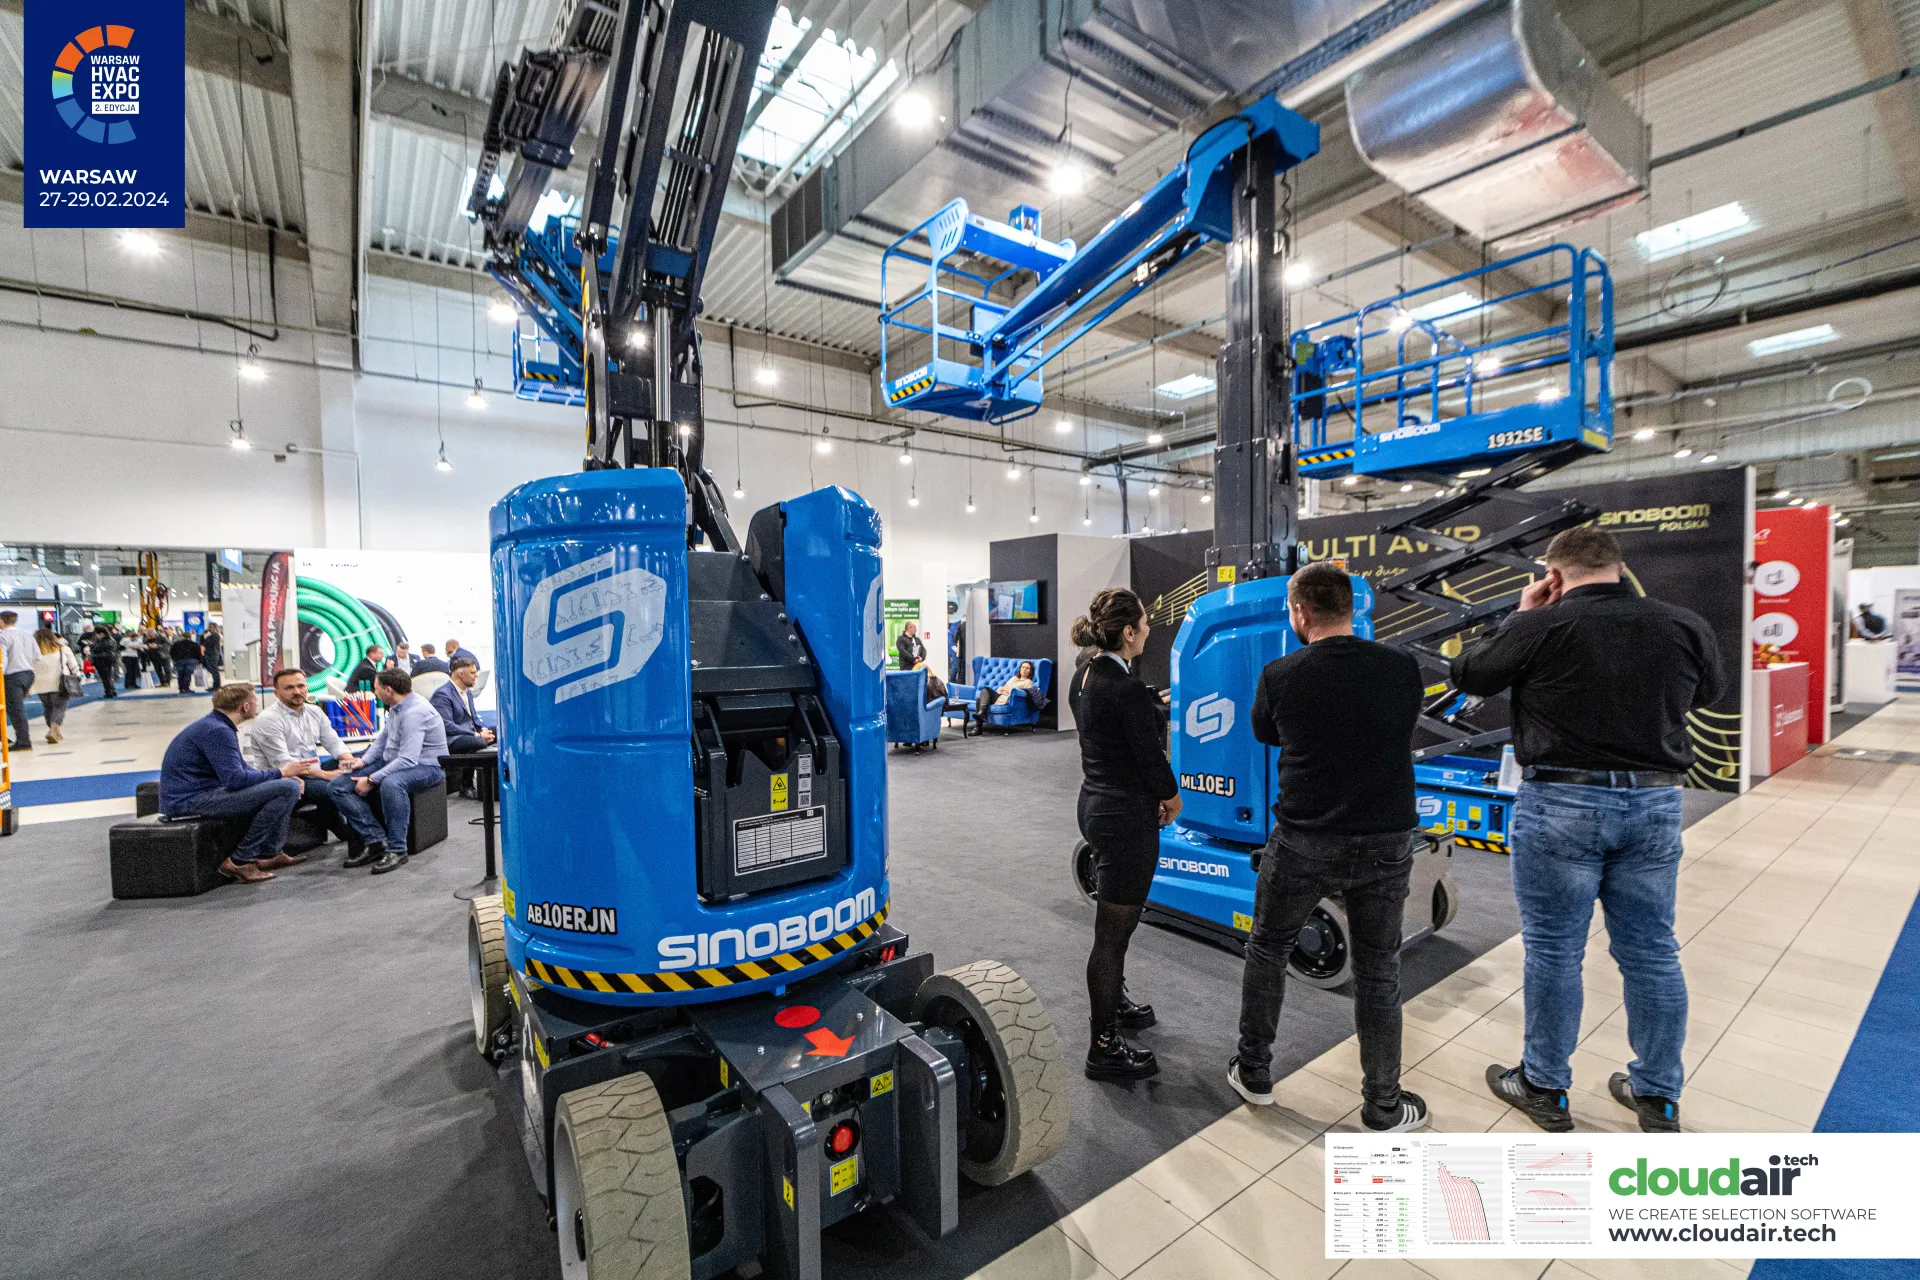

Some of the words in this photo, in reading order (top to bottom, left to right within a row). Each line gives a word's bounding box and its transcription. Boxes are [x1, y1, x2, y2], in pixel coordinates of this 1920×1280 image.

[1486, 425, 1545, 450] 1932SE
[1658, 518, 1710, 532] POLSKA
[1298, 534, 1377, 562] ULTI
[1180, 773, 1235, 798] ML10EJ
[1158, 855, 1230, 878] SINOBOOM
[527, 901, 618, 935] AB10ERJN
[658, 887, 876, 970] SINOBOOM
